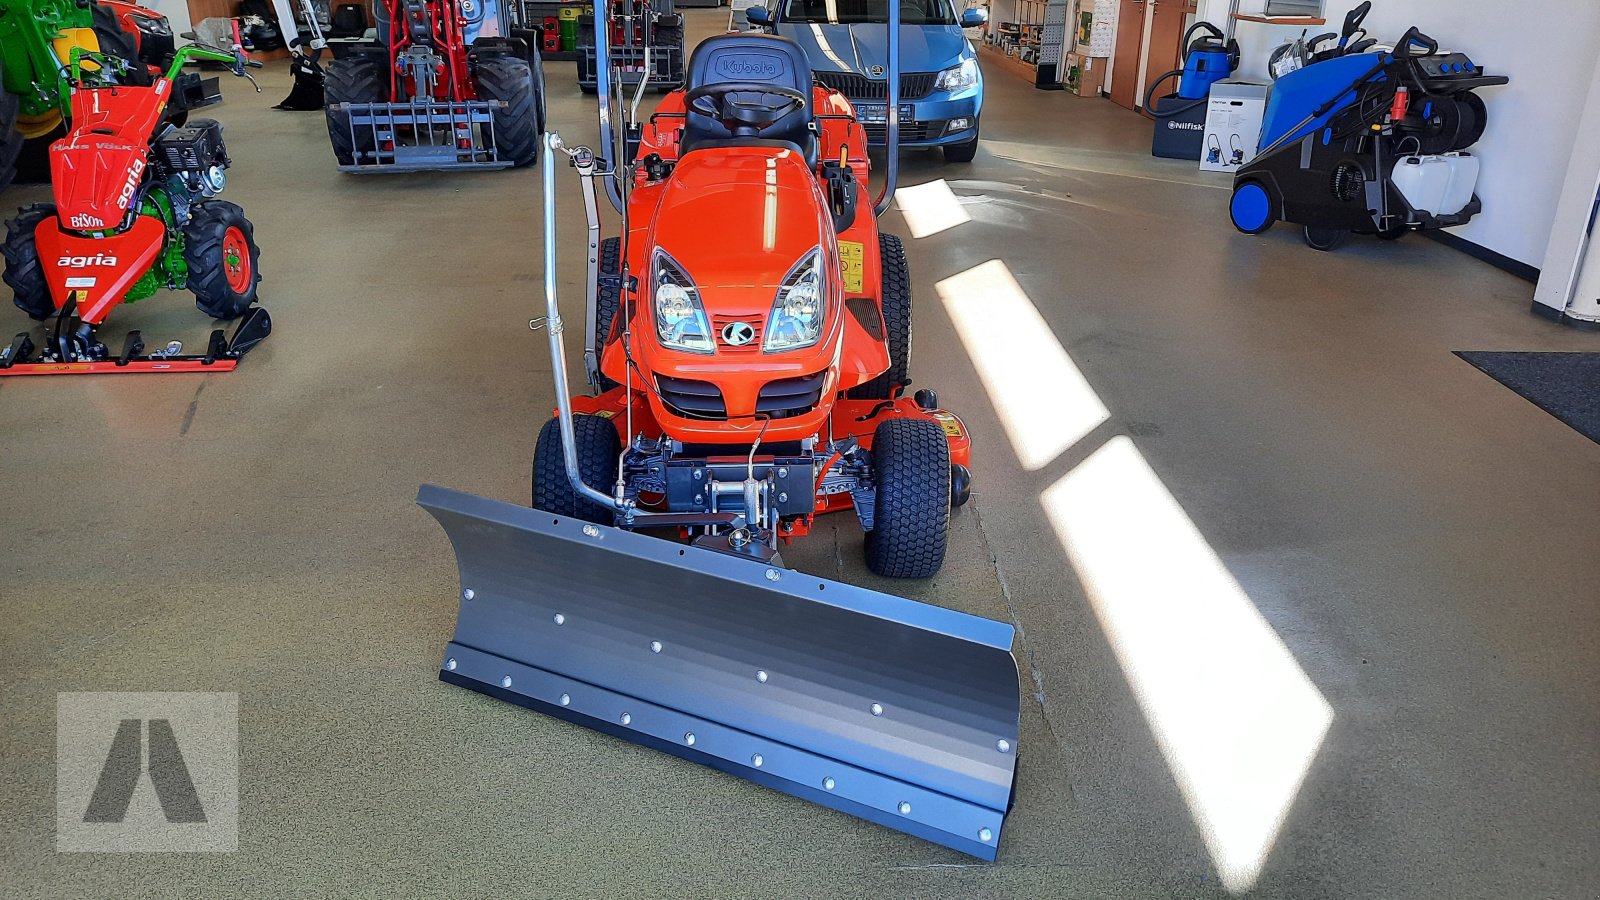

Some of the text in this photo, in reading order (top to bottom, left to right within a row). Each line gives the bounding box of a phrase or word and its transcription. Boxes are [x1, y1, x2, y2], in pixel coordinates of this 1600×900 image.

[723, 60, 776, 75] Kubota
[1175, 122, 1204, 131] Nilfisk
[116, 158, 146, 210] agria
[57, 253, 117, 268] agria
